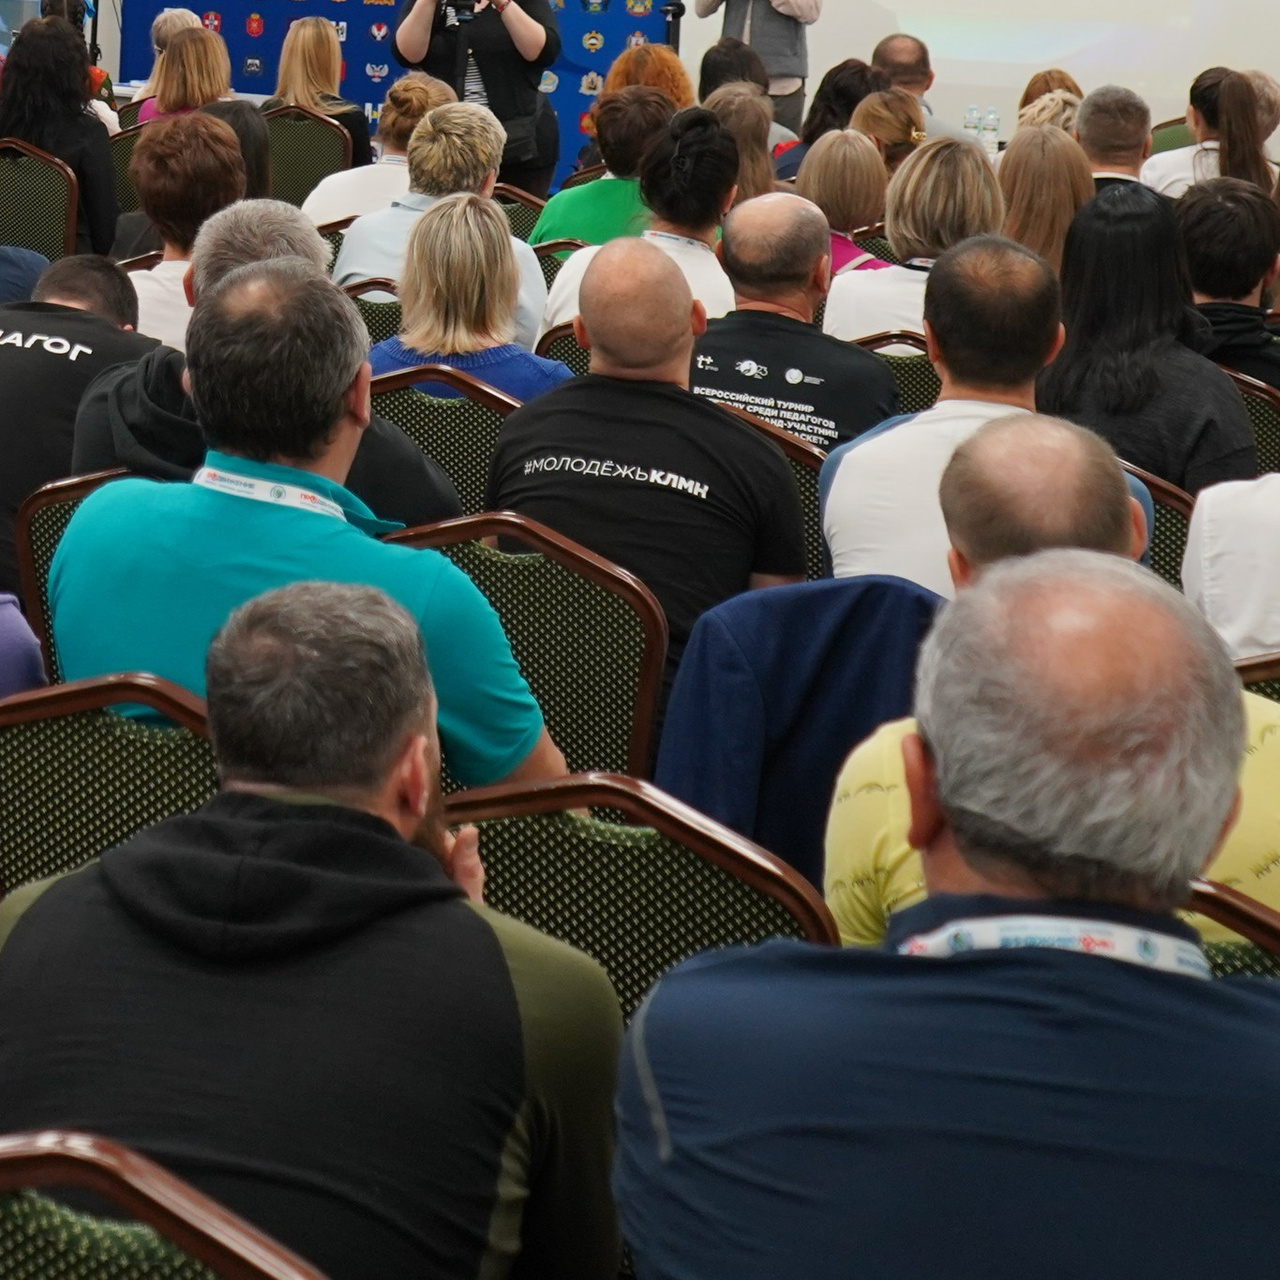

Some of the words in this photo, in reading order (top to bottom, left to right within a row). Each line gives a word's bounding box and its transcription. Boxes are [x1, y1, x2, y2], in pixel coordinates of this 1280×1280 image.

[693, 386, 775, 407] ВСЕРОССИЙСКИЙ
[776, 400, 815, 413] ТУРНИР
[746, 404, 778, 417] СРЕДИ
[779, 410, 836, 429] ПЕДАГОГОВ
